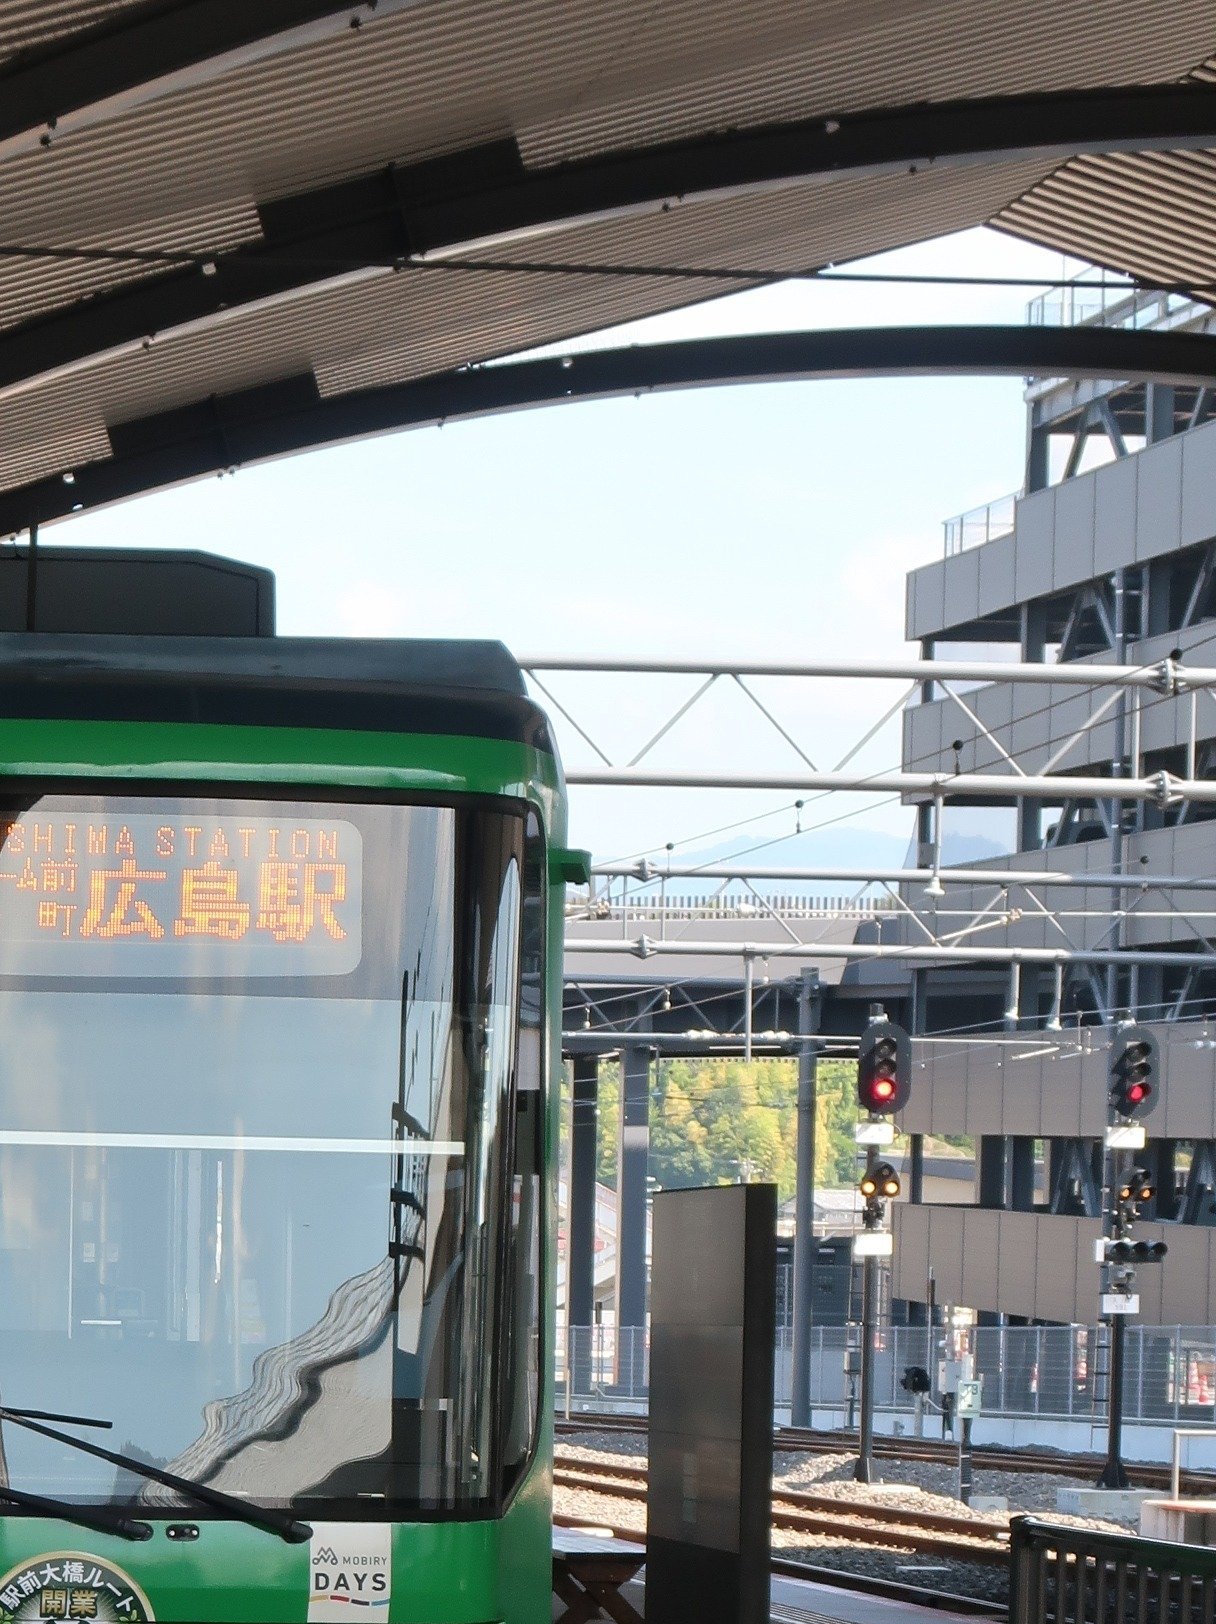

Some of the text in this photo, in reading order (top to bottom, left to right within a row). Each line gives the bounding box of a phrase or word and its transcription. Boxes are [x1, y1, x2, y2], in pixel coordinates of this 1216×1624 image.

[155, 824, 340, 860] STATION
[80, 858, 349, 942] 広島駅
[342, 1556, 388, 1566] MOBIRY
[2, 1561, 135, 1612] 駅前大橋ルート
[315, 1573, 387, 1592] DAYS
[41, 1590, 98, 1615] 開業
